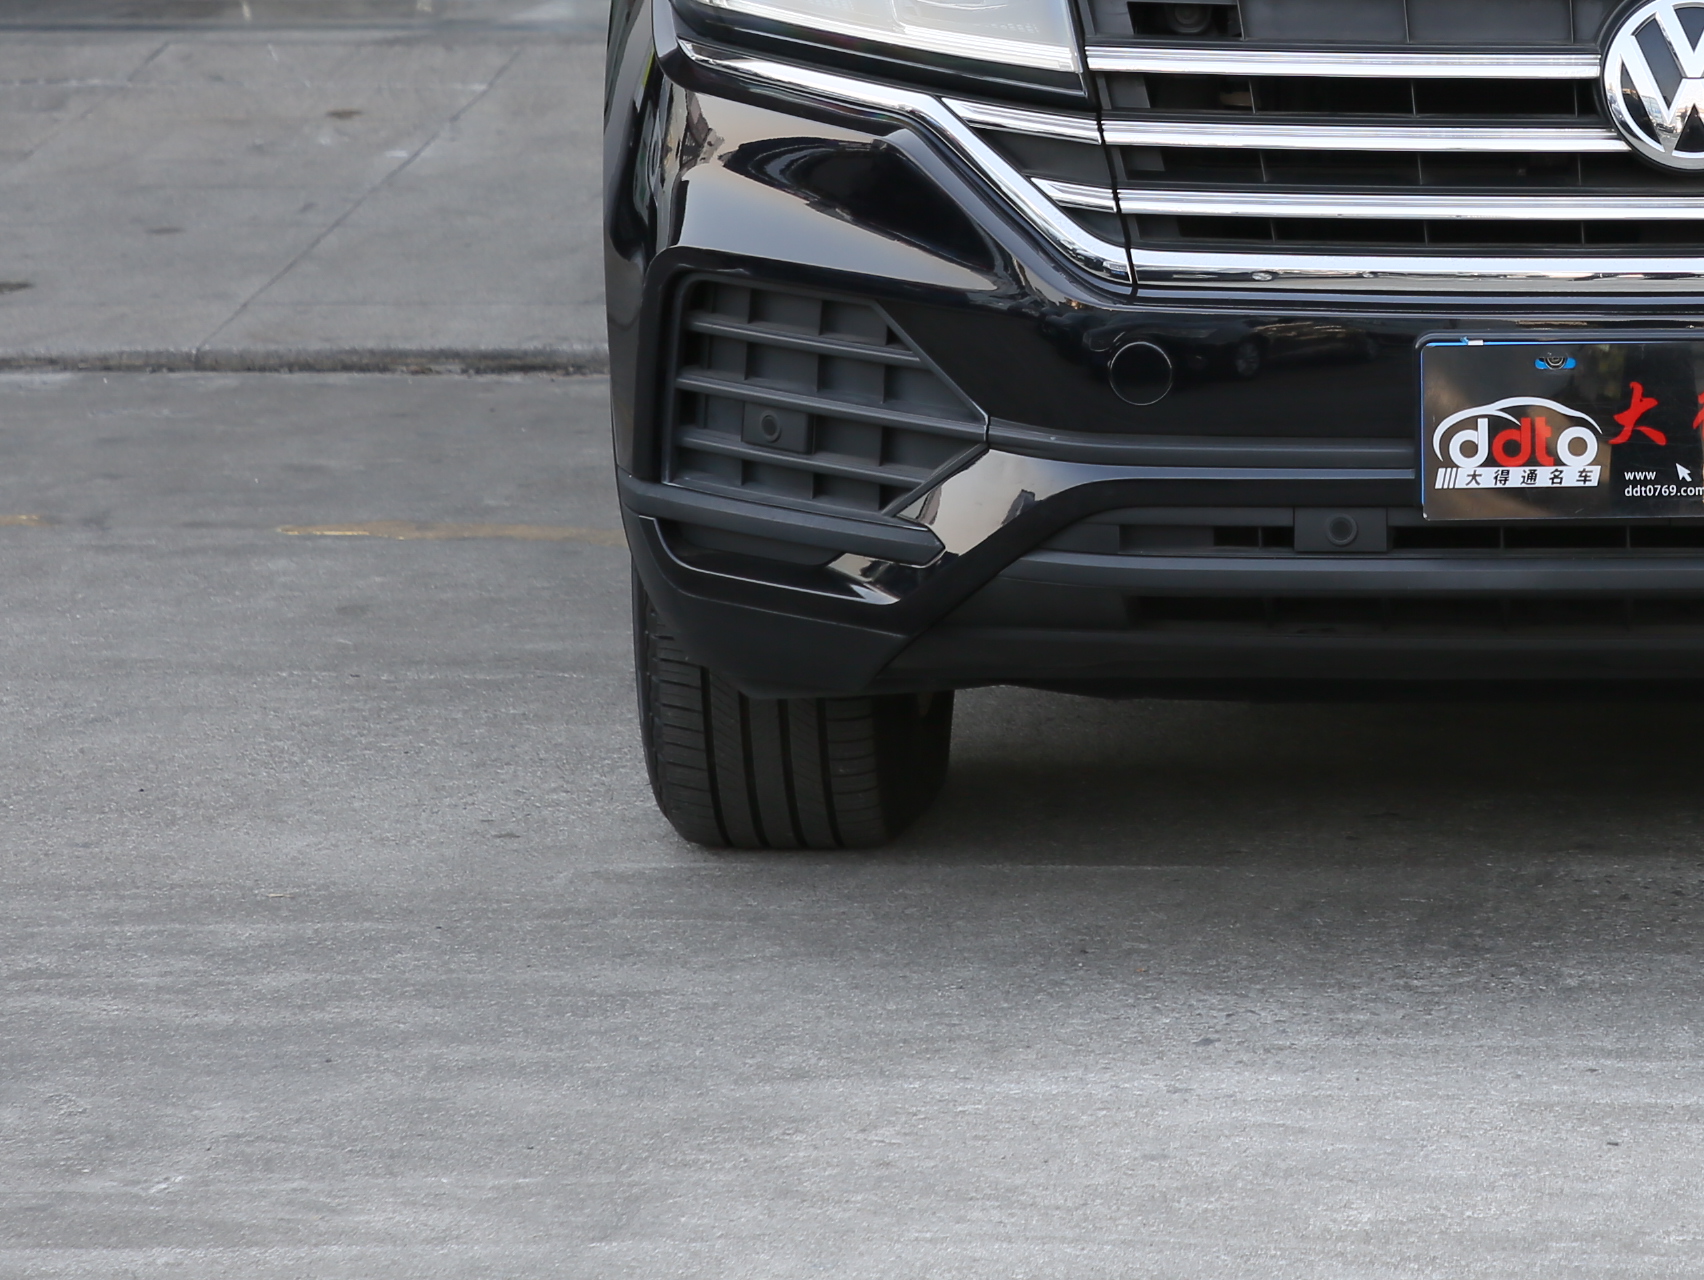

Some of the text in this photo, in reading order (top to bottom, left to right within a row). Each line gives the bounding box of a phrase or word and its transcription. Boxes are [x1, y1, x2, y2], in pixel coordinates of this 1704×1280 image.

[1465, 468, 1593, 487] 大得通名车
[1624, 471, 1656, 481] www
